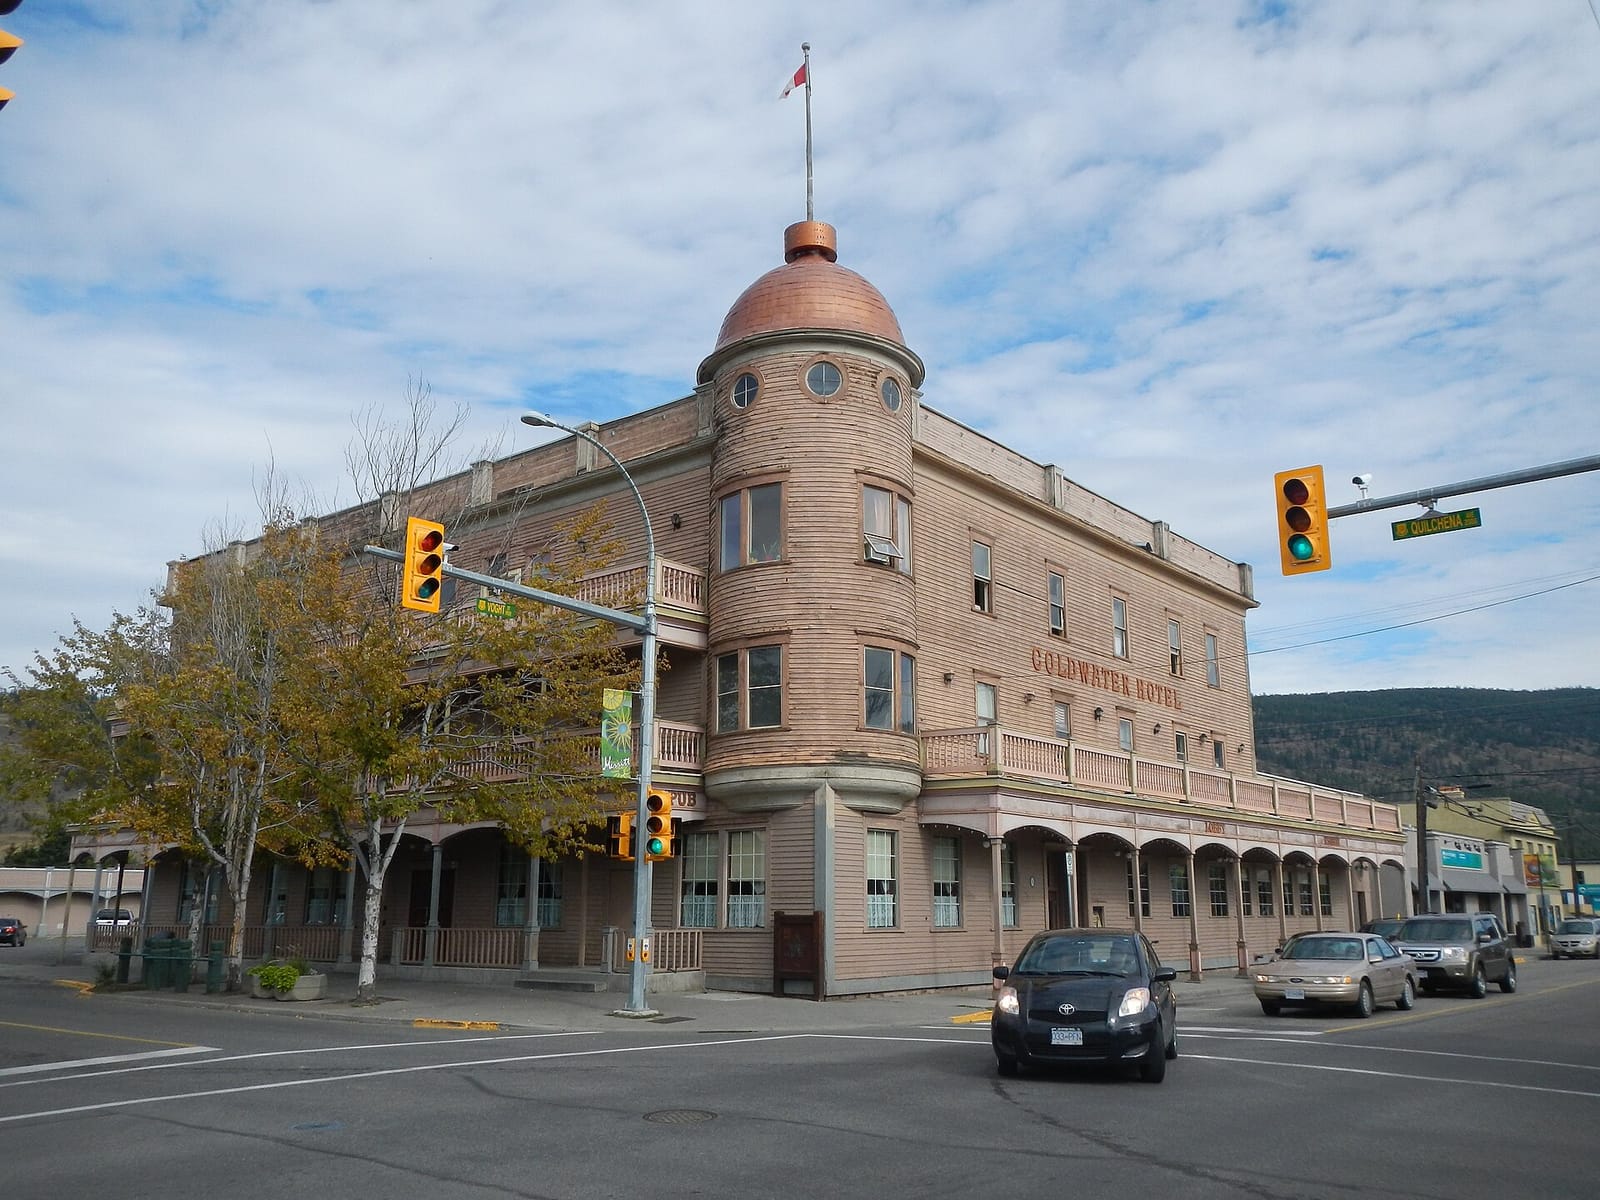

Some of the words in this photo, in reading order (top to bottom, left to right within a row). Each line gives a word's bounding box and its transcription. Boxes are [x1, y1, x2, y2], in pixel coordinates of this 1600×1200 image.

[1410, 513, 1463, 536] QUILCHENA
[487, 601, 506, 615] VOGHT
[1031, 646, 1131, 697] COLDWATER
[1136, 677, 1183, 710] HOTEL
[602, 755, 631, 771] Merritt
[671, 792, 697, 807] PUB
[1205, 821, 1225, 834] LOBBY
